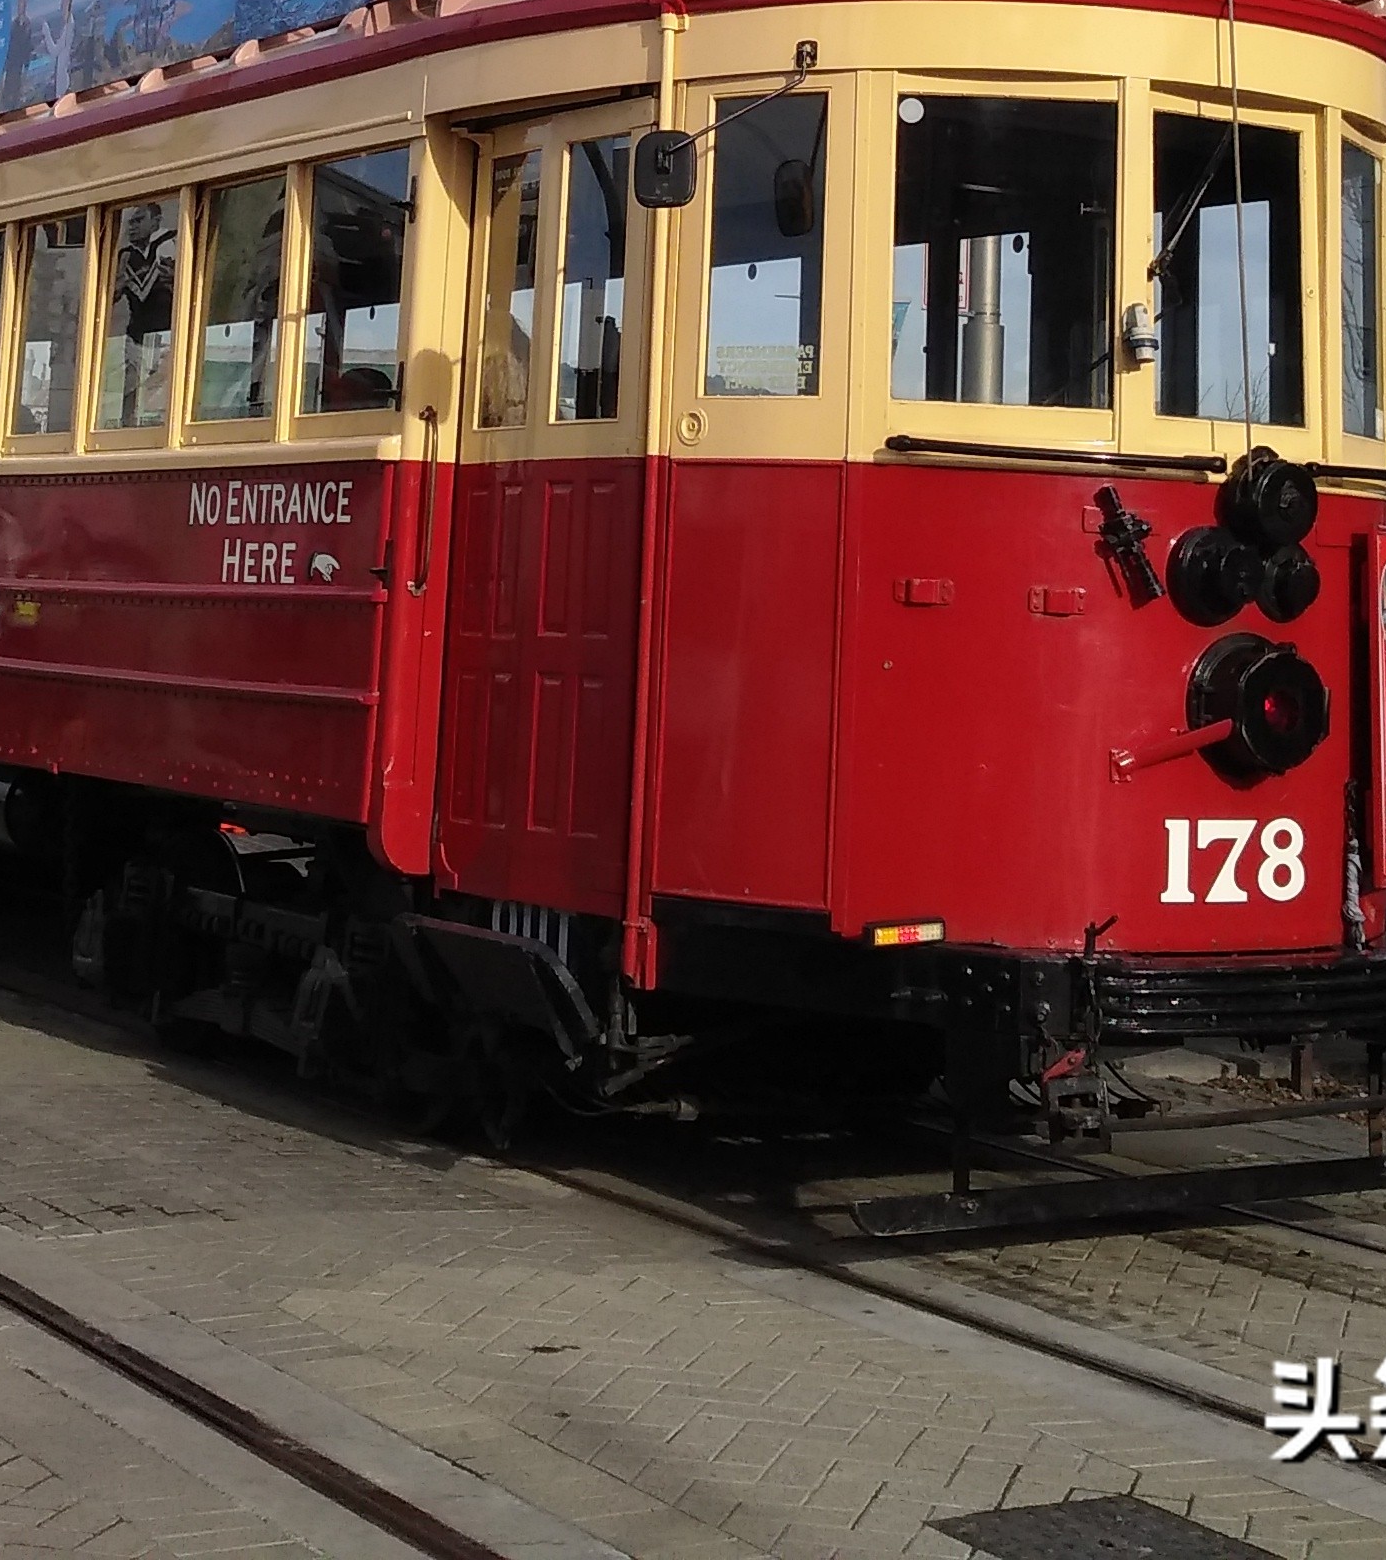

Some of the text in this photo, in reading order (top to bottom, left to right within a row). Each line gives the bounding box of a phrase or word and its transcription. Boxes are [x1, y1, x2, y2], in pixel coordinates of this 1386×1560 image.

[188, 480, 353, 526] NO ENTRANCE
[221, 538, 297, 584] HERE
[1159, 816, 1306, 903] 178
